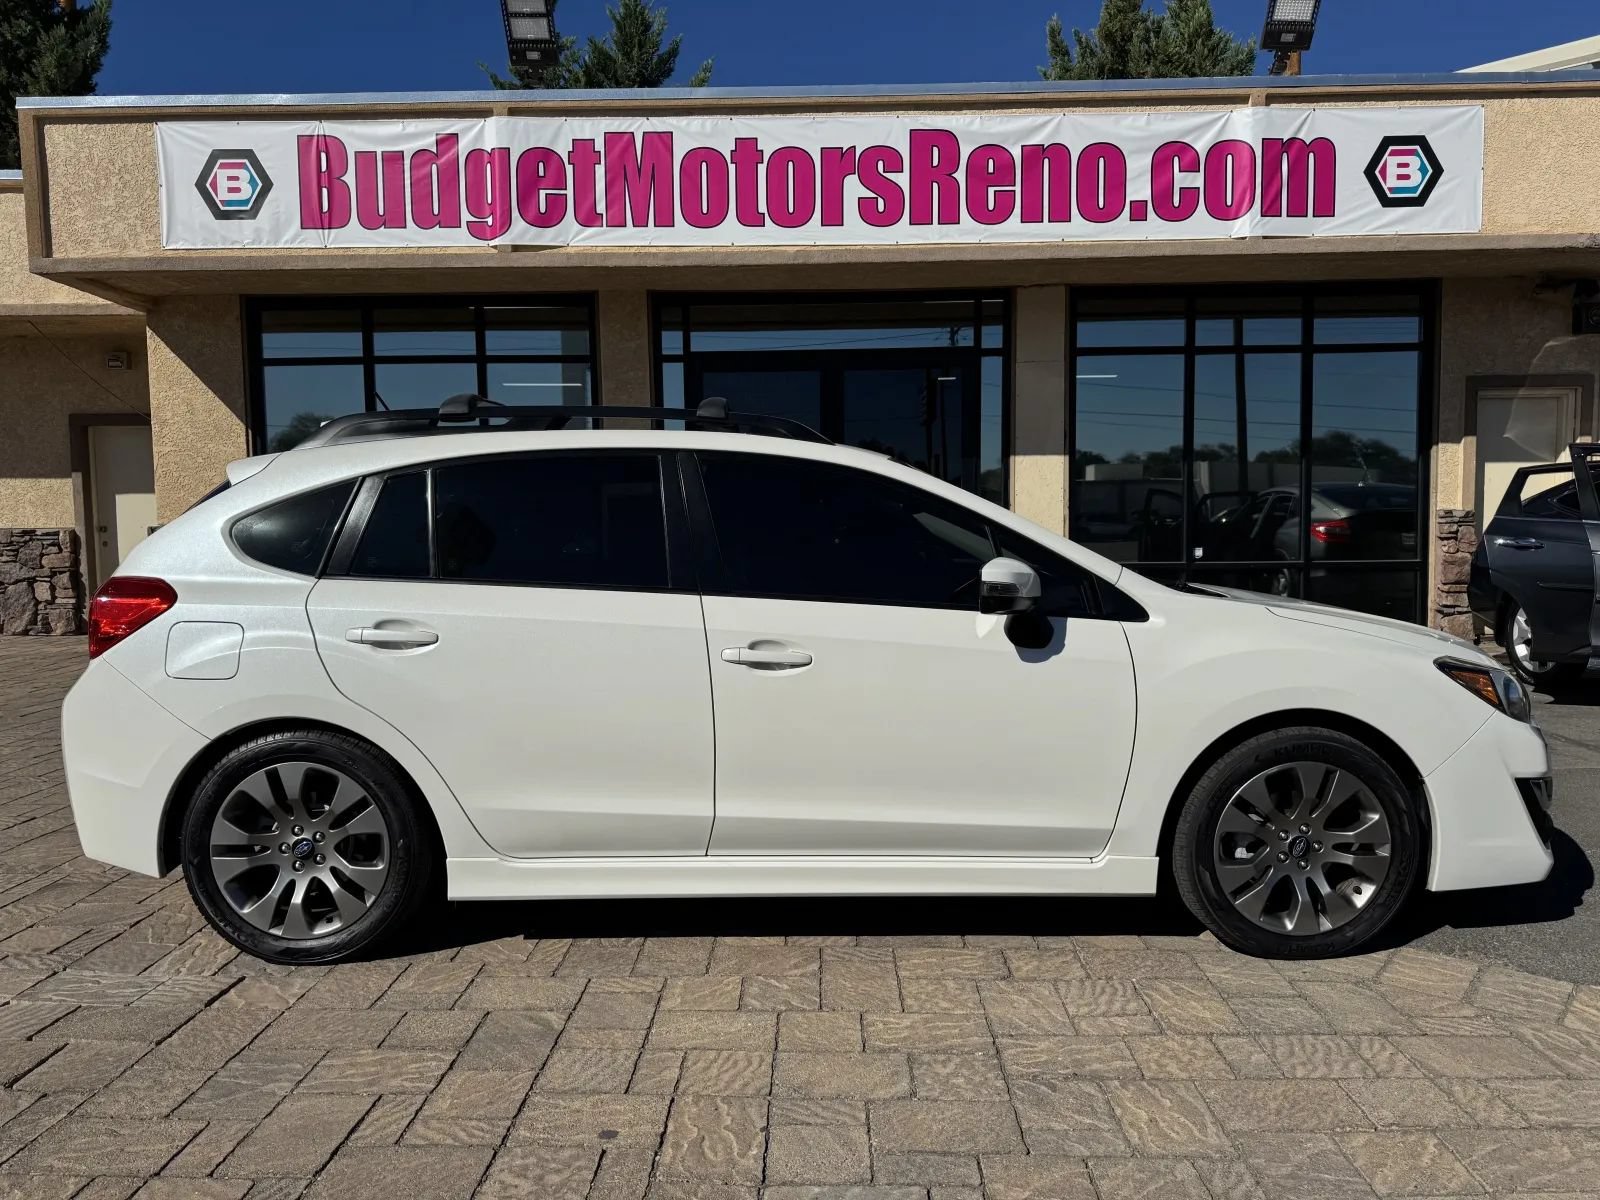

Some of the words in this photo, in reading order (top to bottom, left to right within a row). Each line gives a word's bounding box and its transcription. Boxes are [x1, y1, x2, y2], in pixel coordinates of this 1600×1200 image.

[216, 168, 253, 201] B
[296, 129, 1336, 241] BudgetMotorsReno.com
[1386, 155, 1423, 188] B
